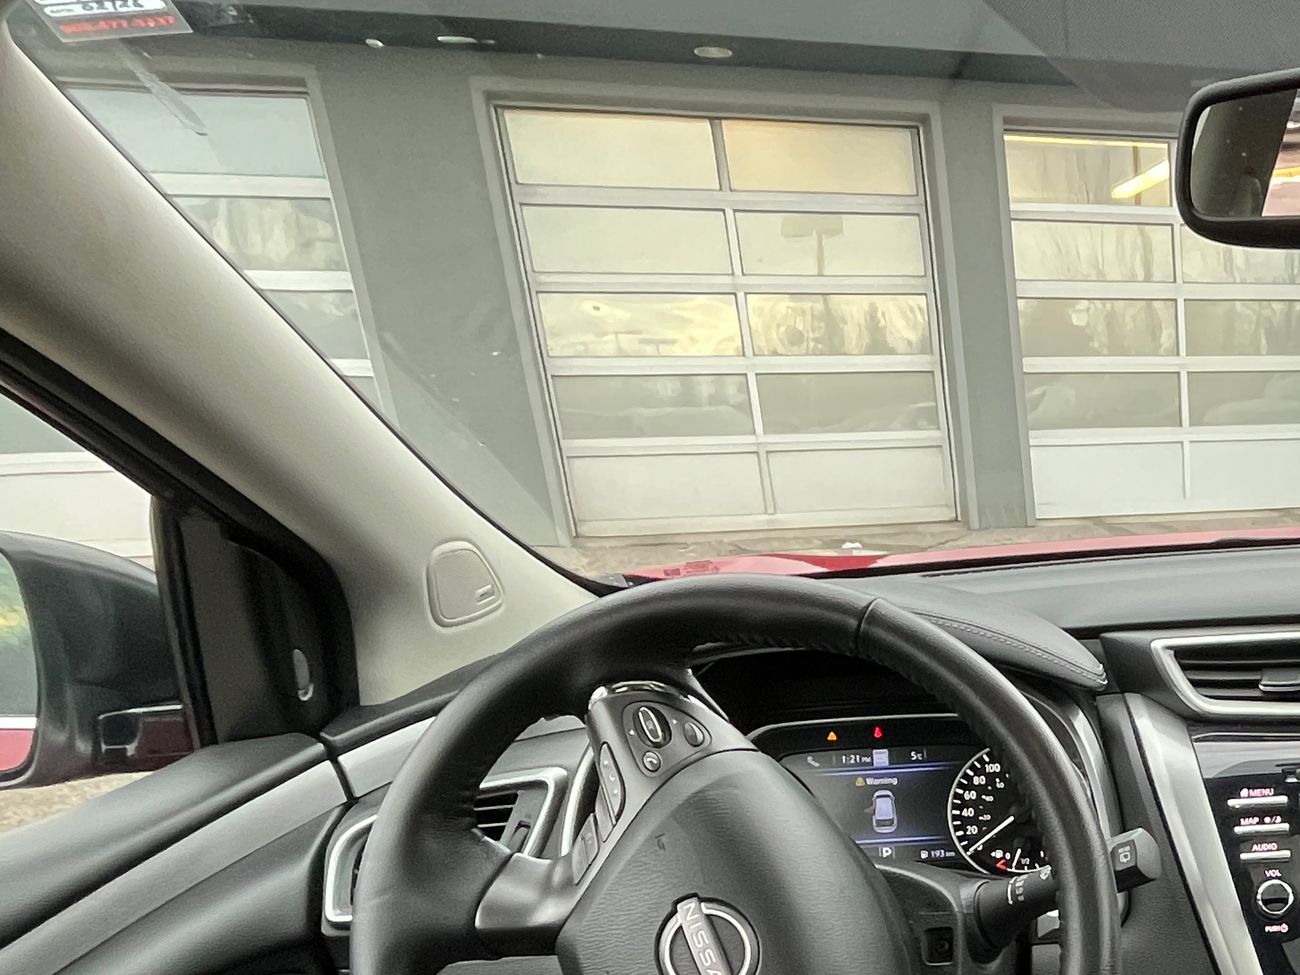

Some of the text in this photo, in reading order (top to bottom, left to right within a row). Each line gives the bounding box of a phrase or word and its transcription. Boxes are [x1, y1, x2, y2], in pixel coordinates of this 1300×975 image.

[841, 754, 860, 764] 1:21
[984, 763, 1001, 773] 100
[866, 777, 898, 786] Warning
[972, 775, 986, 786] 80
[963, 790, 977, 800] 60
[1249, 788, 1275, 797] MENU
[961, 807, 975, 817] 40
[1240, 817, 1260, 826] MAP
[966, 825, 978, 835] 20
[882, 846, 892, 857] P
[1252, 843, 1278, 851] AUDIO
[1265, 869, 1282, 878] VOL
